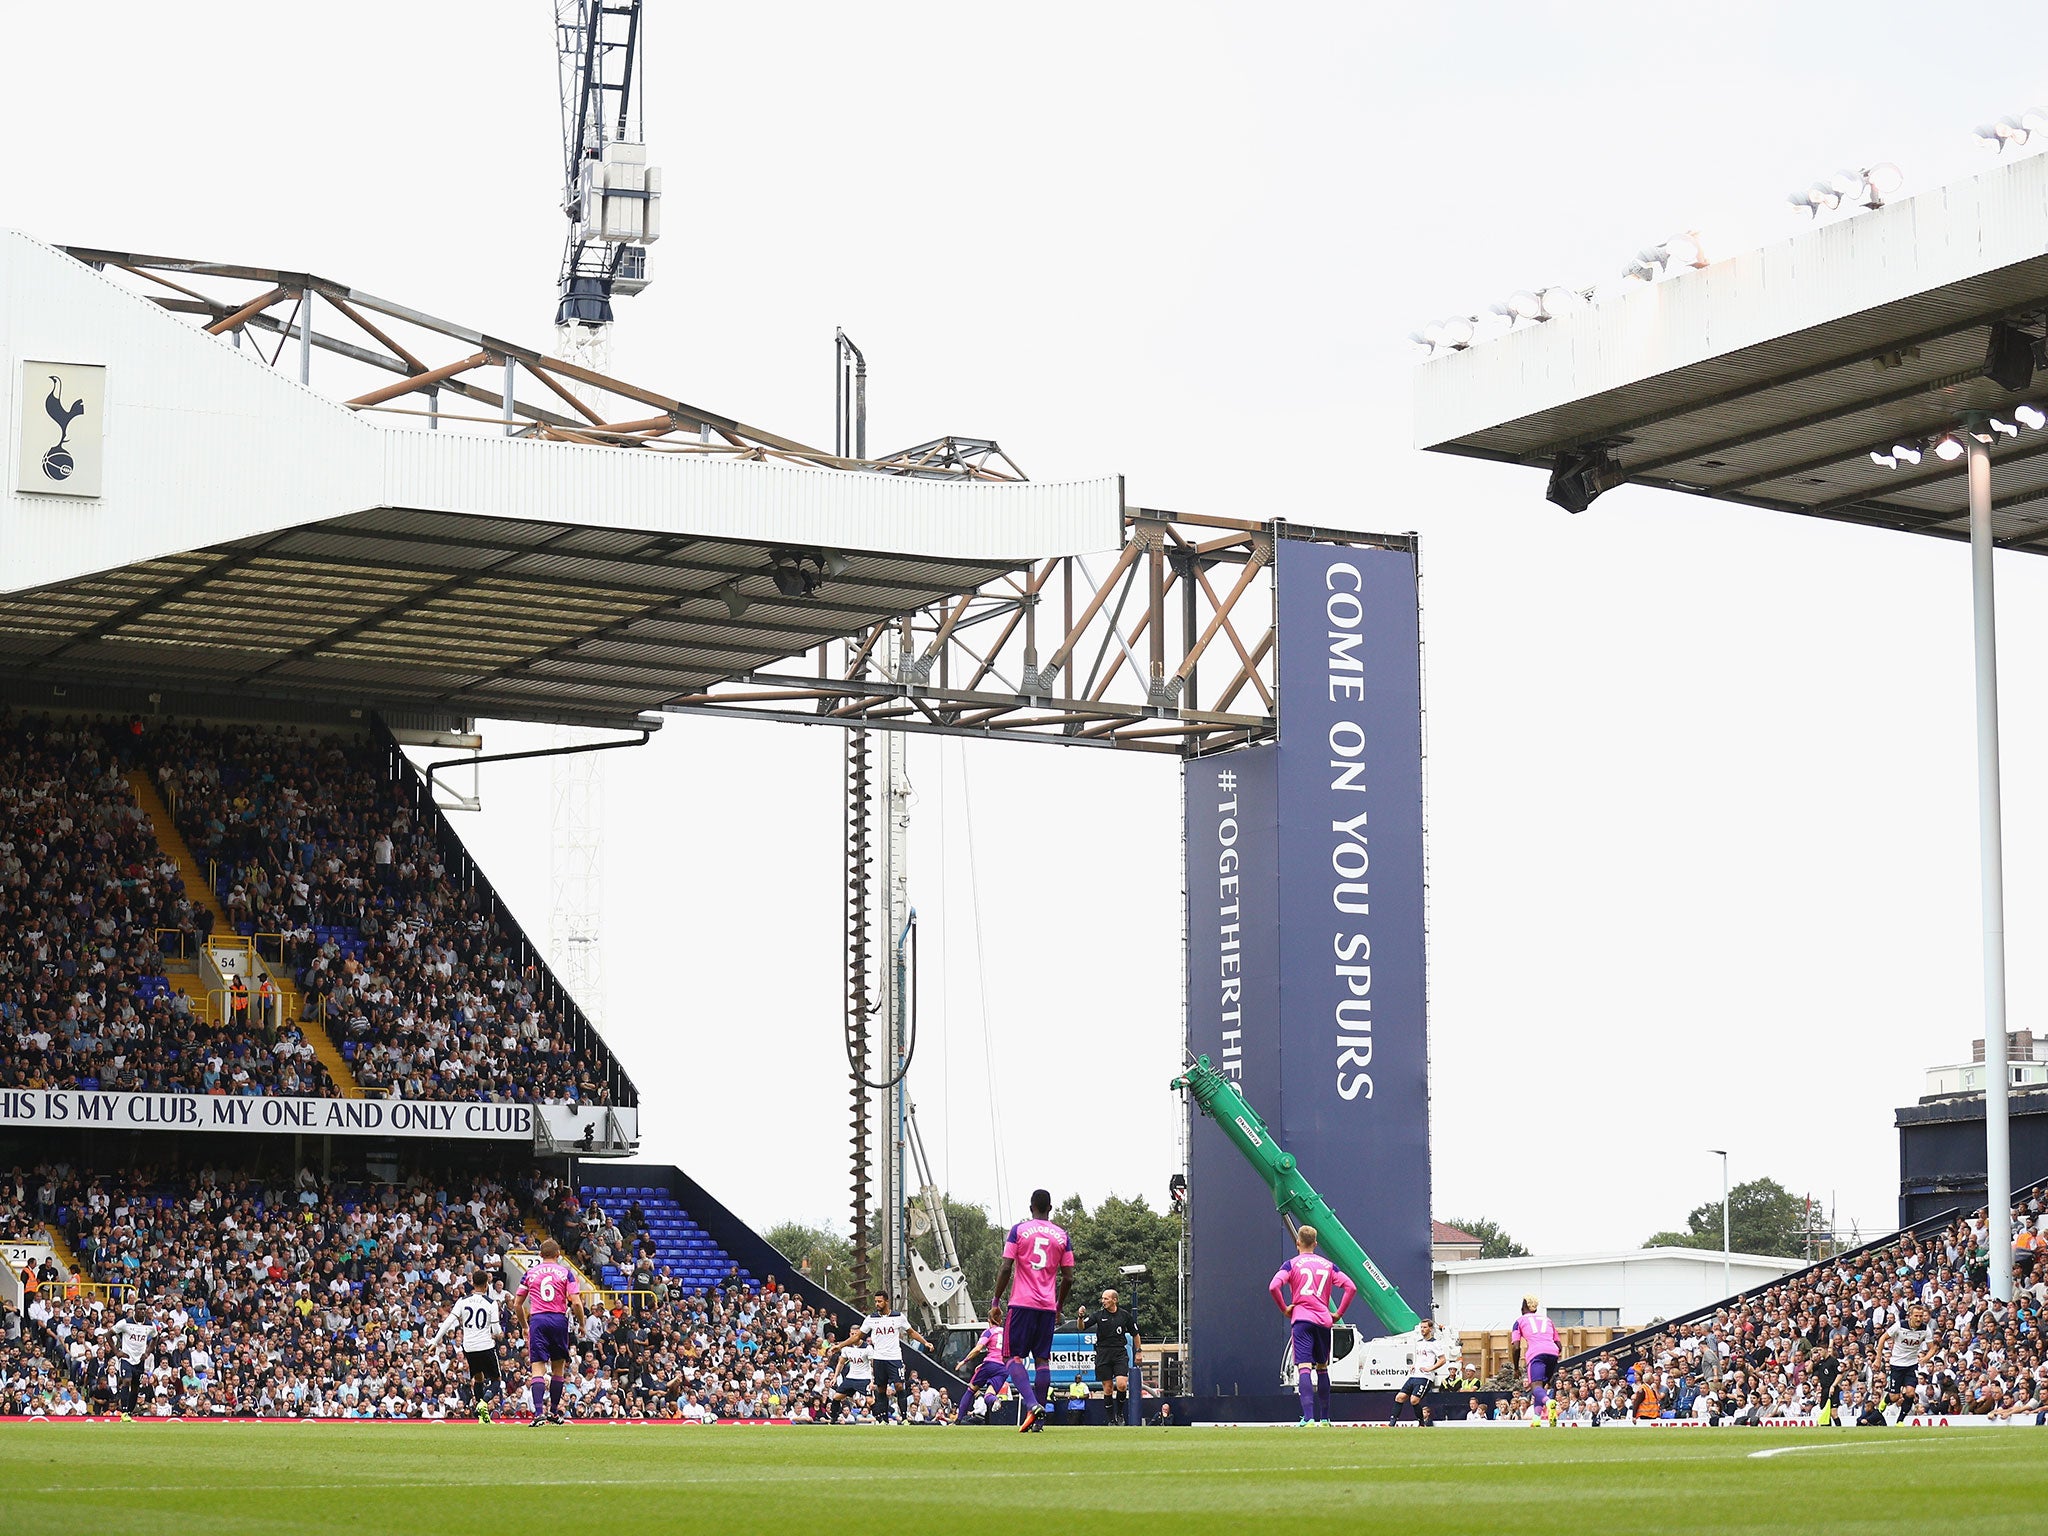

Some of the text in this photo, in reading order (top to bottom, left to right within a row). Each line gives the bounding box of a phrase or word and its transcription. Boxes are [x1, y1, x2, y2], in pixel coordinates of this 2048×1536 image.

[1326, 562, 1373, 1101] COME ON YOU SPURS
[221, 957, 235, 968] 54
[45, 1093, 69, 1120] IS
[77, 1095, 119, 1121] MY
[127, 1096, 203, 1128] CLUB,
[213, 1098, 254, 1125] MY
[262, 1100, 317, 1127] ONE
[326, 1102, 383, 1128] AND
[391, 1103, 457, 1130] ONLY
[465, 1106, 531, 1133] CLUB
[12, 1249, 27, 1259] 21
[1030, 1237, 1049, 1270] 5
[527, 1259, 541, 1268] 22
[540, 1276, 555, 1302] 6
[1300, 1268, 1329, 1298] 27
[464, 1307, 487, 1330] 20
[1528, 1317, 1547, 1334] 17
[129, 1333, 146, 1343] AIA
[875, 1326, 895, 1336] AIA
[1901, 1338, 1920, 1346] AIA
